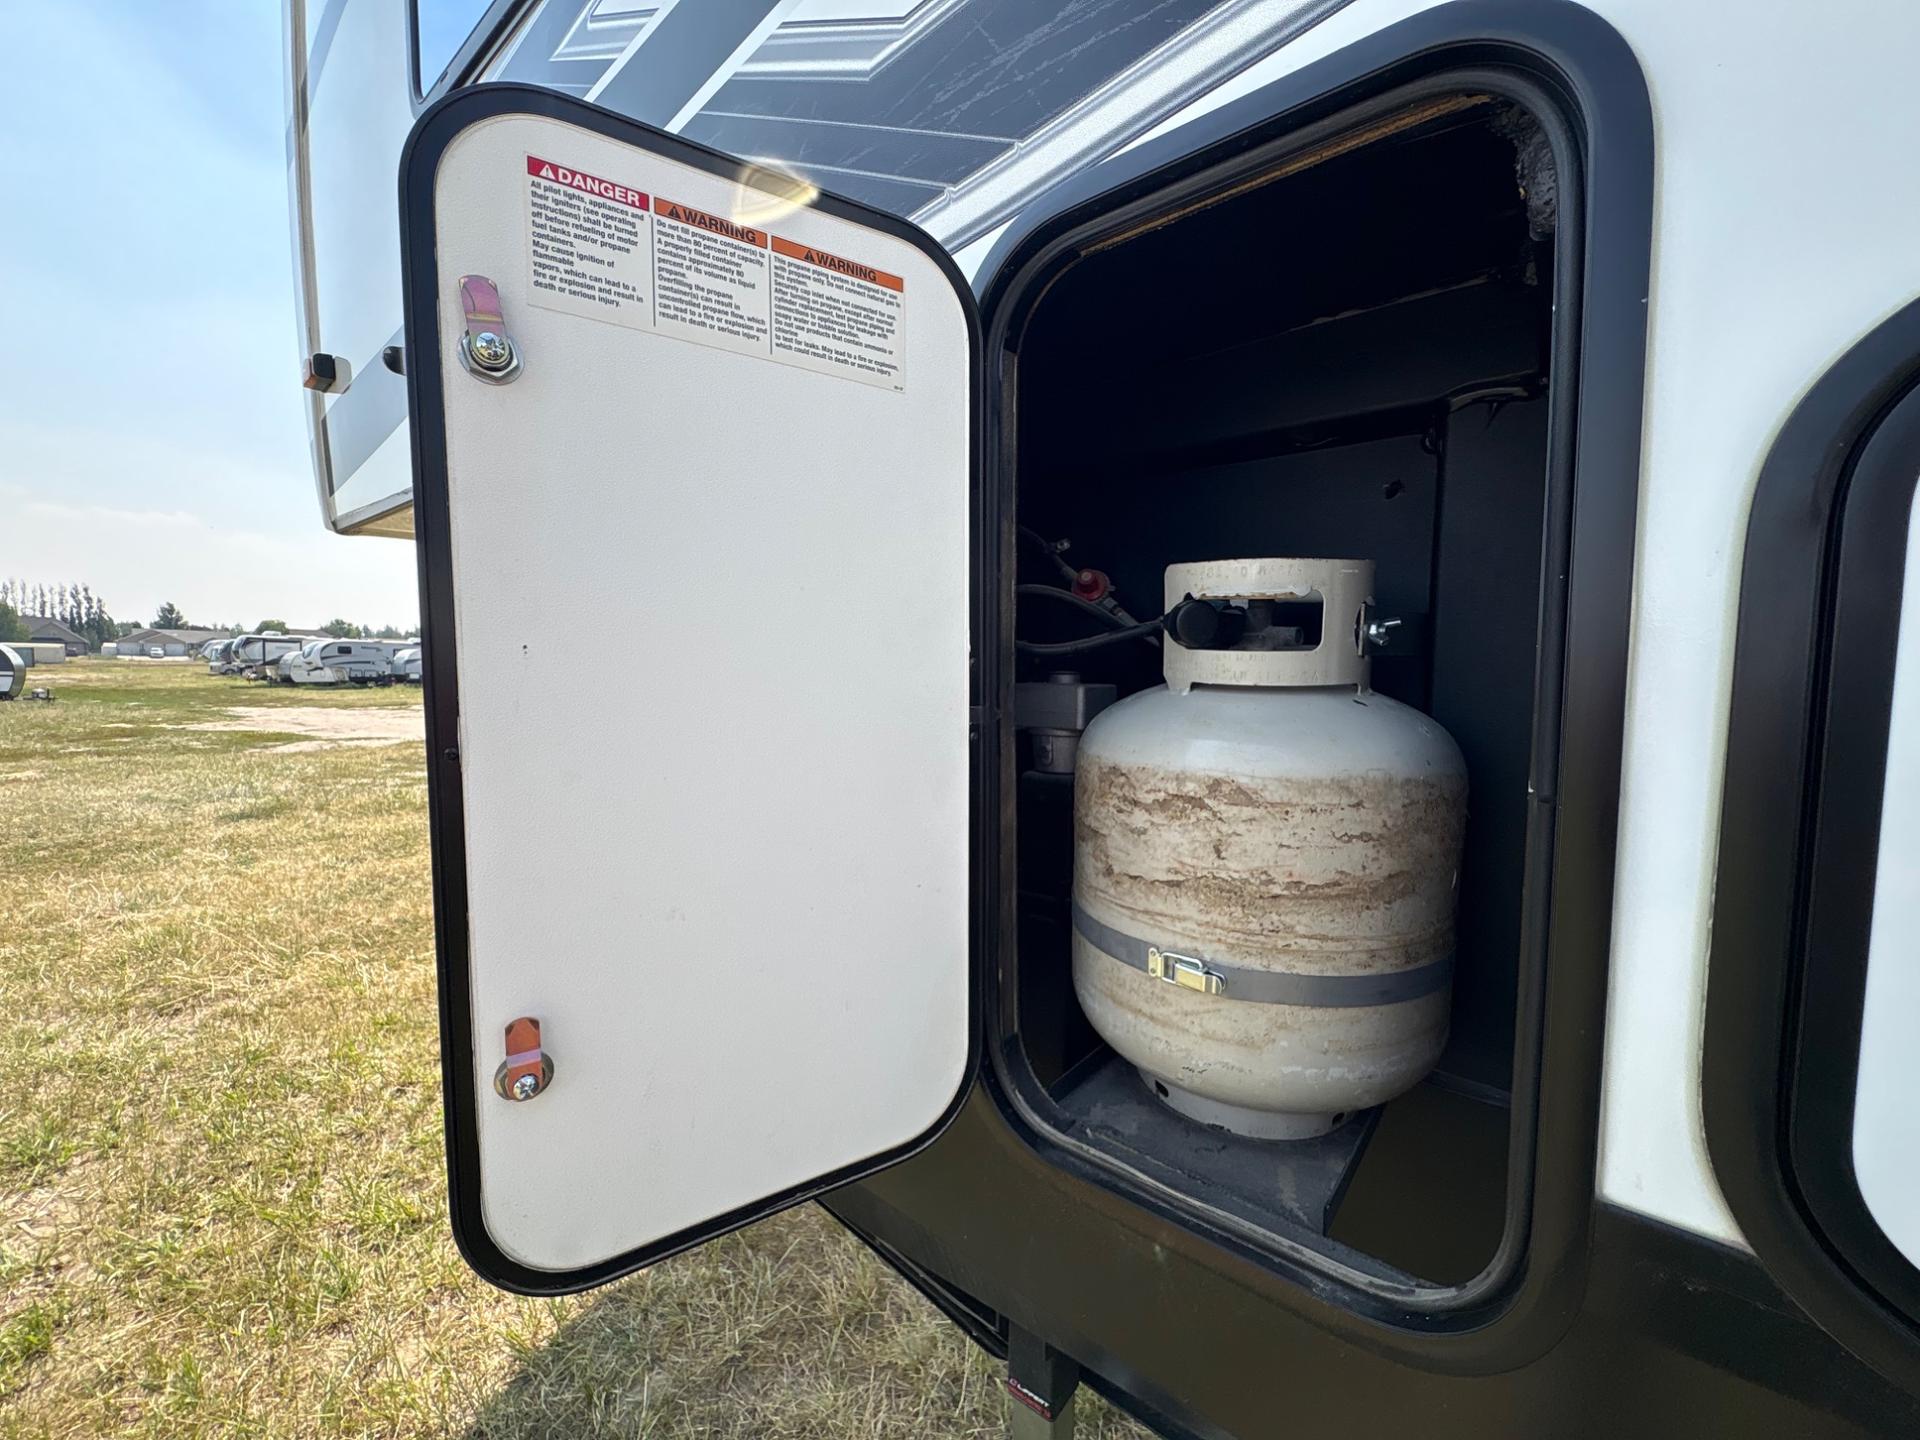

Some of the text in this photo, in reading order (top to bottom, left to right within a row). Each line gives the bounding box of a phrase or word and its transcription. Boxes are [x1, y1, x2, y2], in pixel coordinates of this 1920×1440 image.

[530, 180, 541, 190] All
[543, 184, 560, 198] pilot
[588, 198, 628, 218] appliances
[630, 211, 644, 221] and
[558, 168, 639, 206] DANGER
[530, 190, 635, 230] their igniters (see operating
[531, 200, 638, 238] instructions) shall be turned
[683, 209, 755, 243] WARNING
[531, 209, 638, 247] off before refueling of motor
[531, 219, 630, 256] fuel tanks and/or propane
[532, 239, 614, 268] May cause ignition of
[532, 249, 574, 267] flammable
[816, 253, 876, 282] WARNING
[533, 268, 546, 279] fire
[559, 275, 595, 293] explosion
[597, 285, 611, 295] and
[613, 289, 634, 301] result
[636, 295, 643, 303] in
[533, 278, 555, 291] death
[568, 287, 596, 301] serious
[563, 267, 586, 280] which
[588, 275, 602, 284] can
[604, 277, 620, 288] lead
[622, 282, 629, 291] to
